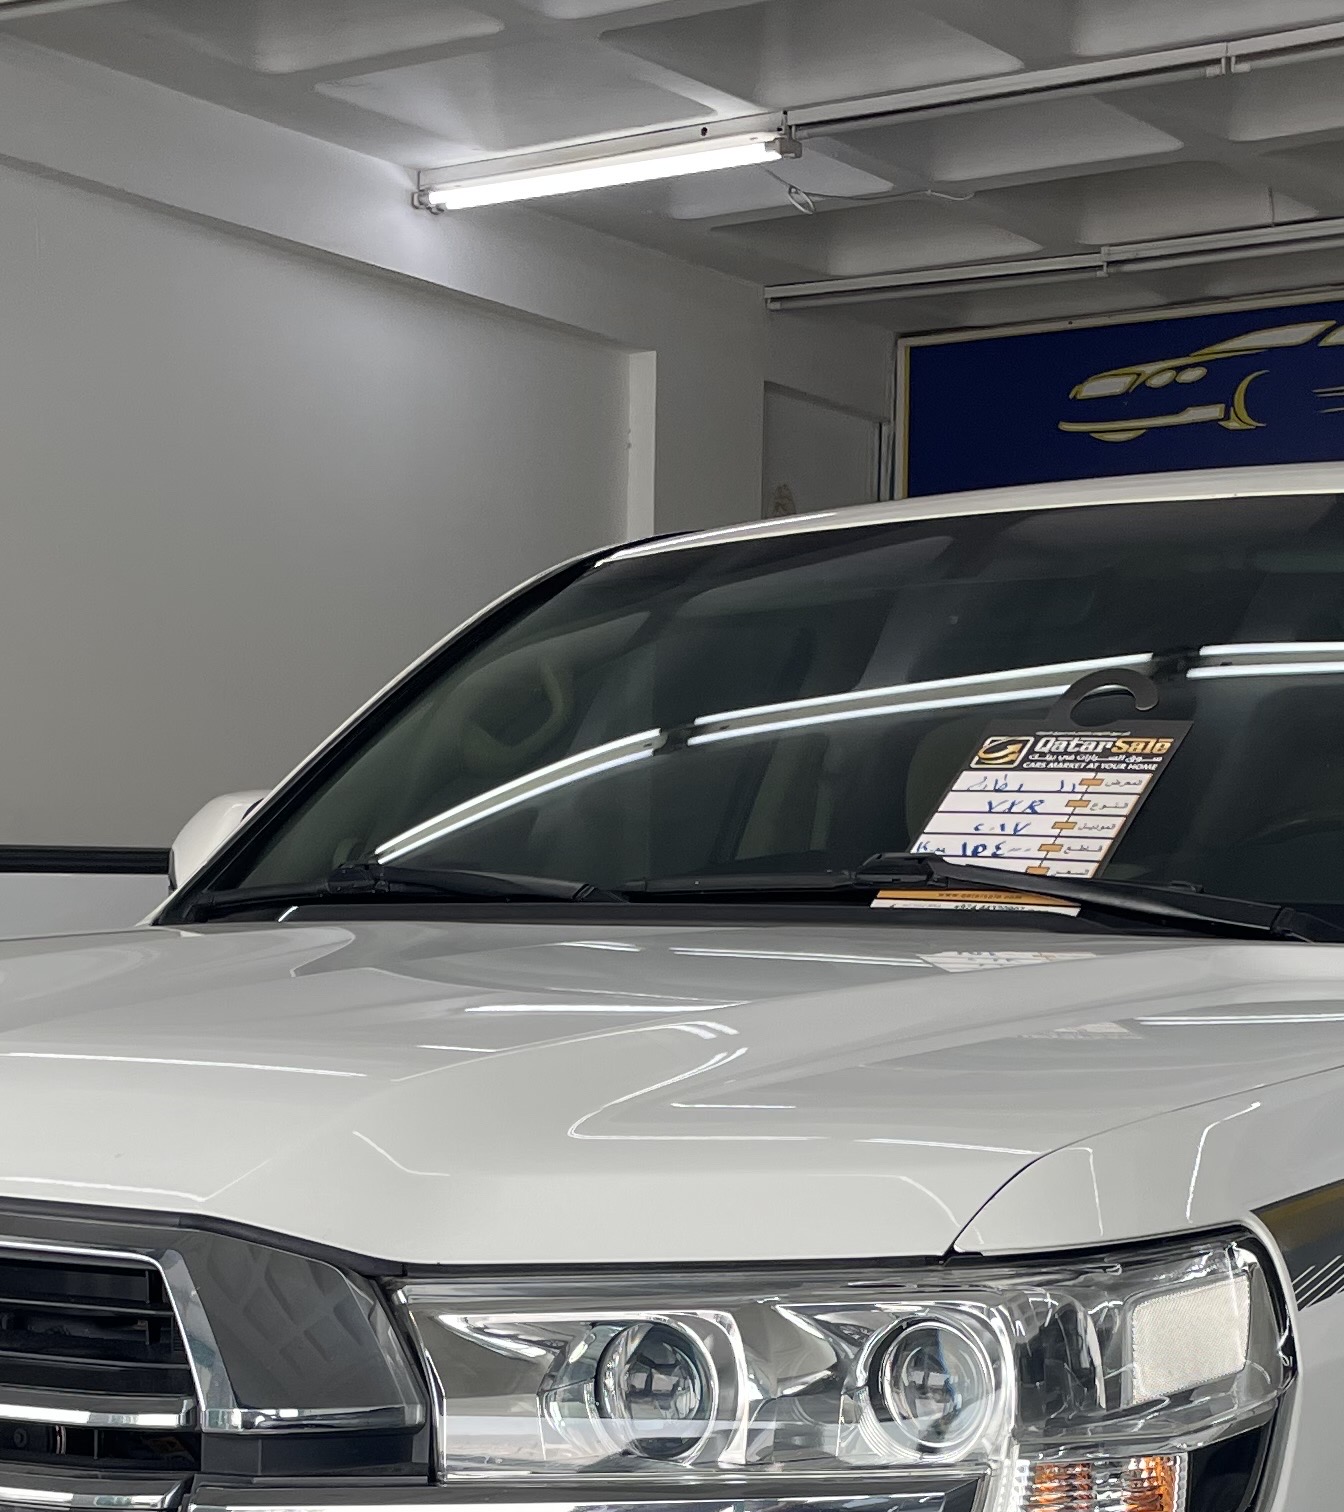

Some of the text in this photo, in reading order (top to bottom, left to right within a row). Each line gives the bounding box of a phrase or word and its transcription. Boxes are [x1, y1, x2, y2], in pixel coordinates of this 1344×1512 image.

[1034, 736, 1174, 754] QatarSale
[1022, 761, 1046, 769] CARS
[1127, 763, 1158, 771] HOME
